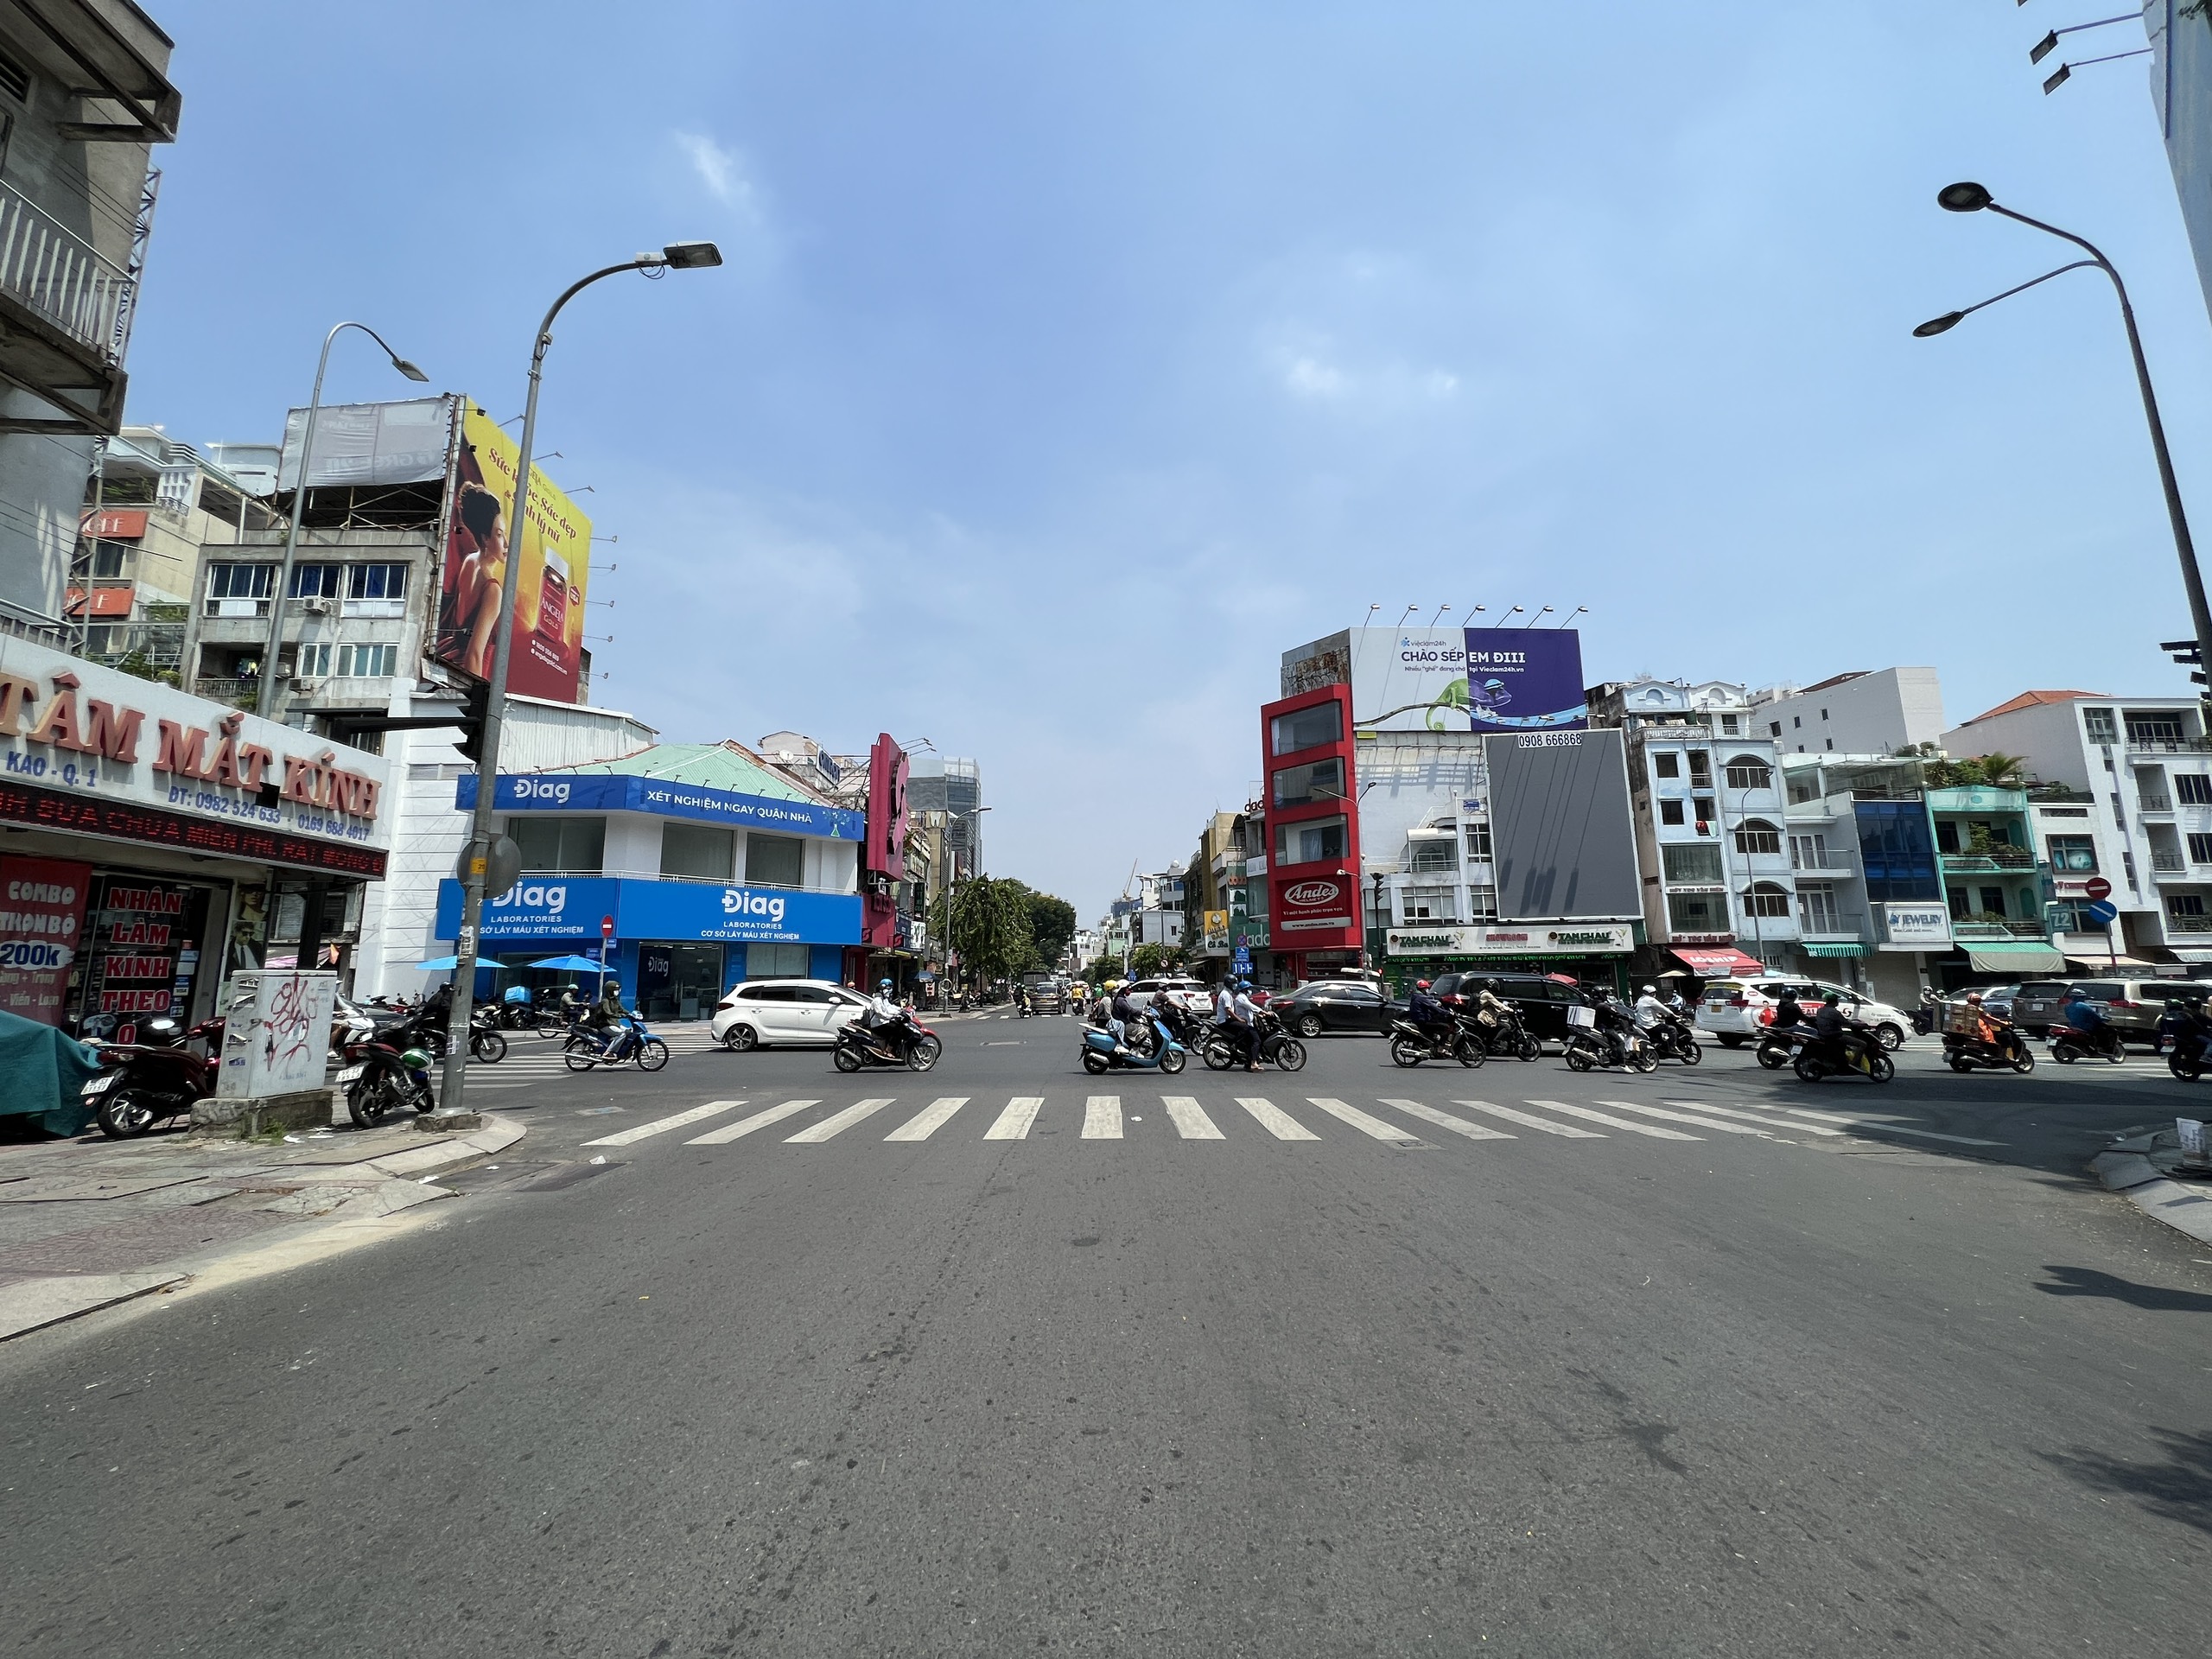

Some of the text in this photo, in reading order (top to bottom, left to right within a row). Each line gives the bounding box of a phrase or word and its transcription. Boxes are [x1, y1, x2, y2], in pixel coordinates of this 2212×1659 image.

[488, 448, 511, 475] Sức
[1401, 646, 1526, 664] CHÀO SẾP EM ĐIII
[0, 671, 146, 764] TÂM
[152, 712, 274, 793] MẮT
[1518, 733, 1582, 747] 0908 666868
[6, 751, 47, 777] KAO
[63, 764, 79, 787] Q.
[86, 768, 96, 787] 1
[278, 752, 383, 821] KÍNH
[195, 791, 230, 814] 0982
[232, 799, 256, 819] 524
[258, 808, 283, 824] 633
[297, 813, 324, 832] 0169
[326, 819, 345, 836] 688
[346, 824, 371, 842] 4017
[646, 790, 813, 824] XÉT NGHIỆM NGAY QUẬN NHÀ
[8, 880, 76, 906] COMBO
[107, 886, 183, 918] NHẬN
[1287, 884, 1338, 899] Andes
[721, 889, 785, 922] Diag
[110, 917, 171, 947] LÀM
[490, 915, 563, 924] LABORATORIES
[512, 925, 532, 935] MÁU
[532, 925, 550, 935] XÉT
[550, 925, 584, 936] NGHIỆM
[722, 921, 783, 930] LABORATORIES
[1902, 914, 1943, 925] JEWELRY
[2050, 912, 2071, 927] 72
[714, 929, 727, 938] SỞ
[742, 931, 759, 939] MÁU
[759, 931, 772, 940] XÉT
[773, 932, 800, 941] NGHIỆM
[0, 943, 61, 967] 200k
[103, 951, 172, 979] KÍNH
[99, 989, 171, 1014] THEO
